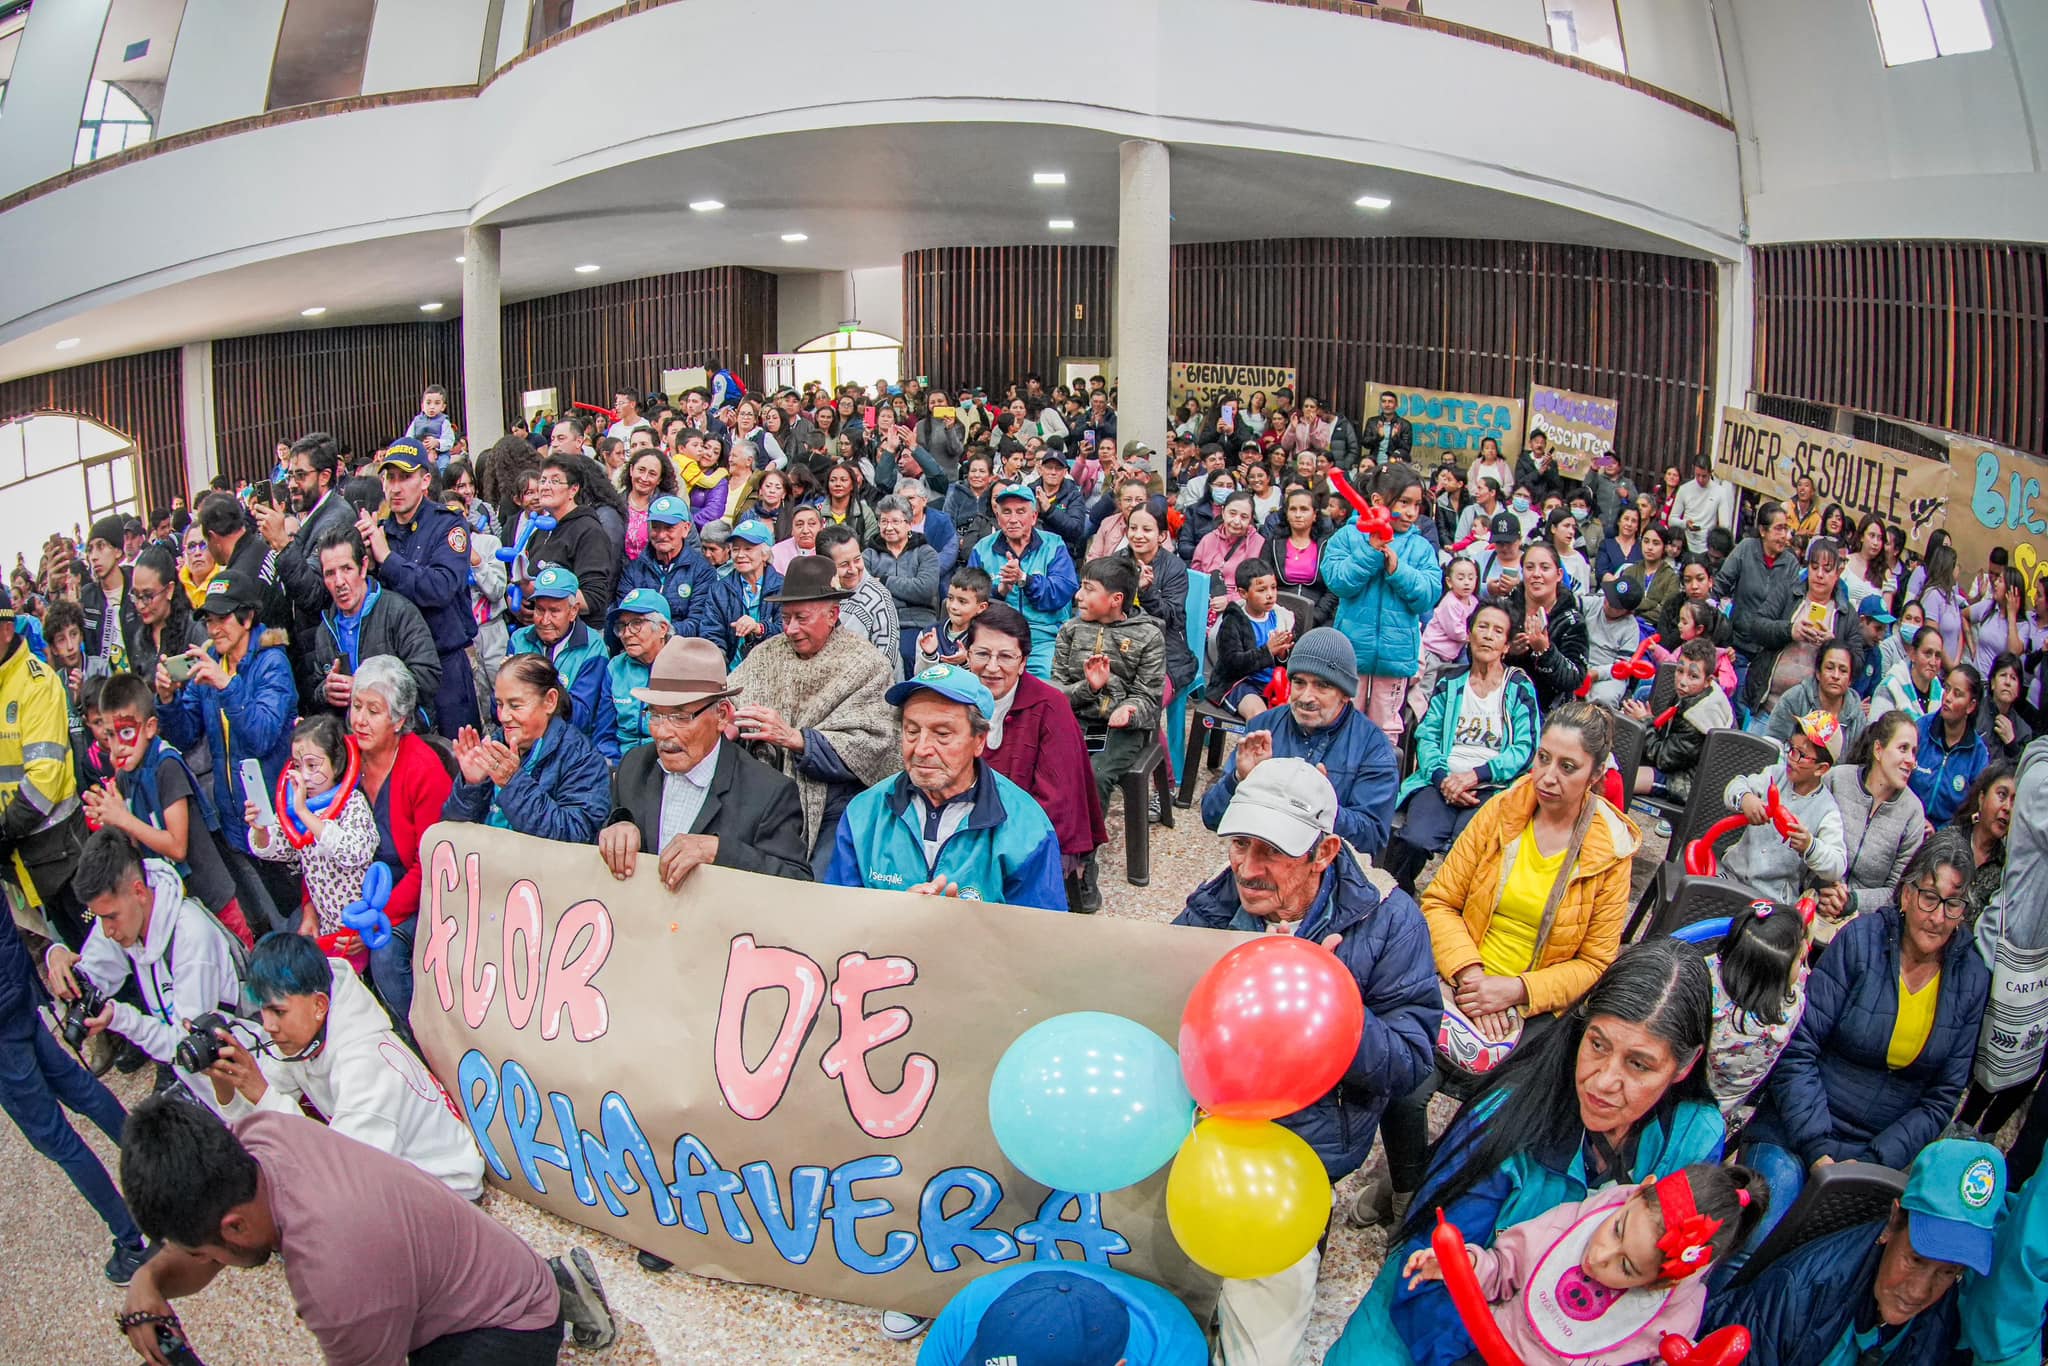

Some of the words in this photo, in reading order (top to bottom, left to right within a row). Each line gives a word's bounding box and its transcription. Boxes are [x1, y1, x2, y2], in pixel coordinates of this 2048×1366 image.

[1186, 365, 1286, 387] BIENVENIDO
[1379, 393, 1511, 430] UDOTECA
[1718, 420, 1782, 480] IMDER
[1791, 441, 1909, 523] SESQUILE
[1971, 451, 2048, 535] BIE
[423, 840, 614, 1042] FLOR
[713, 933, 938, 1139] DE
[457, 1048, 1132, 1275] PRIMAVERA
